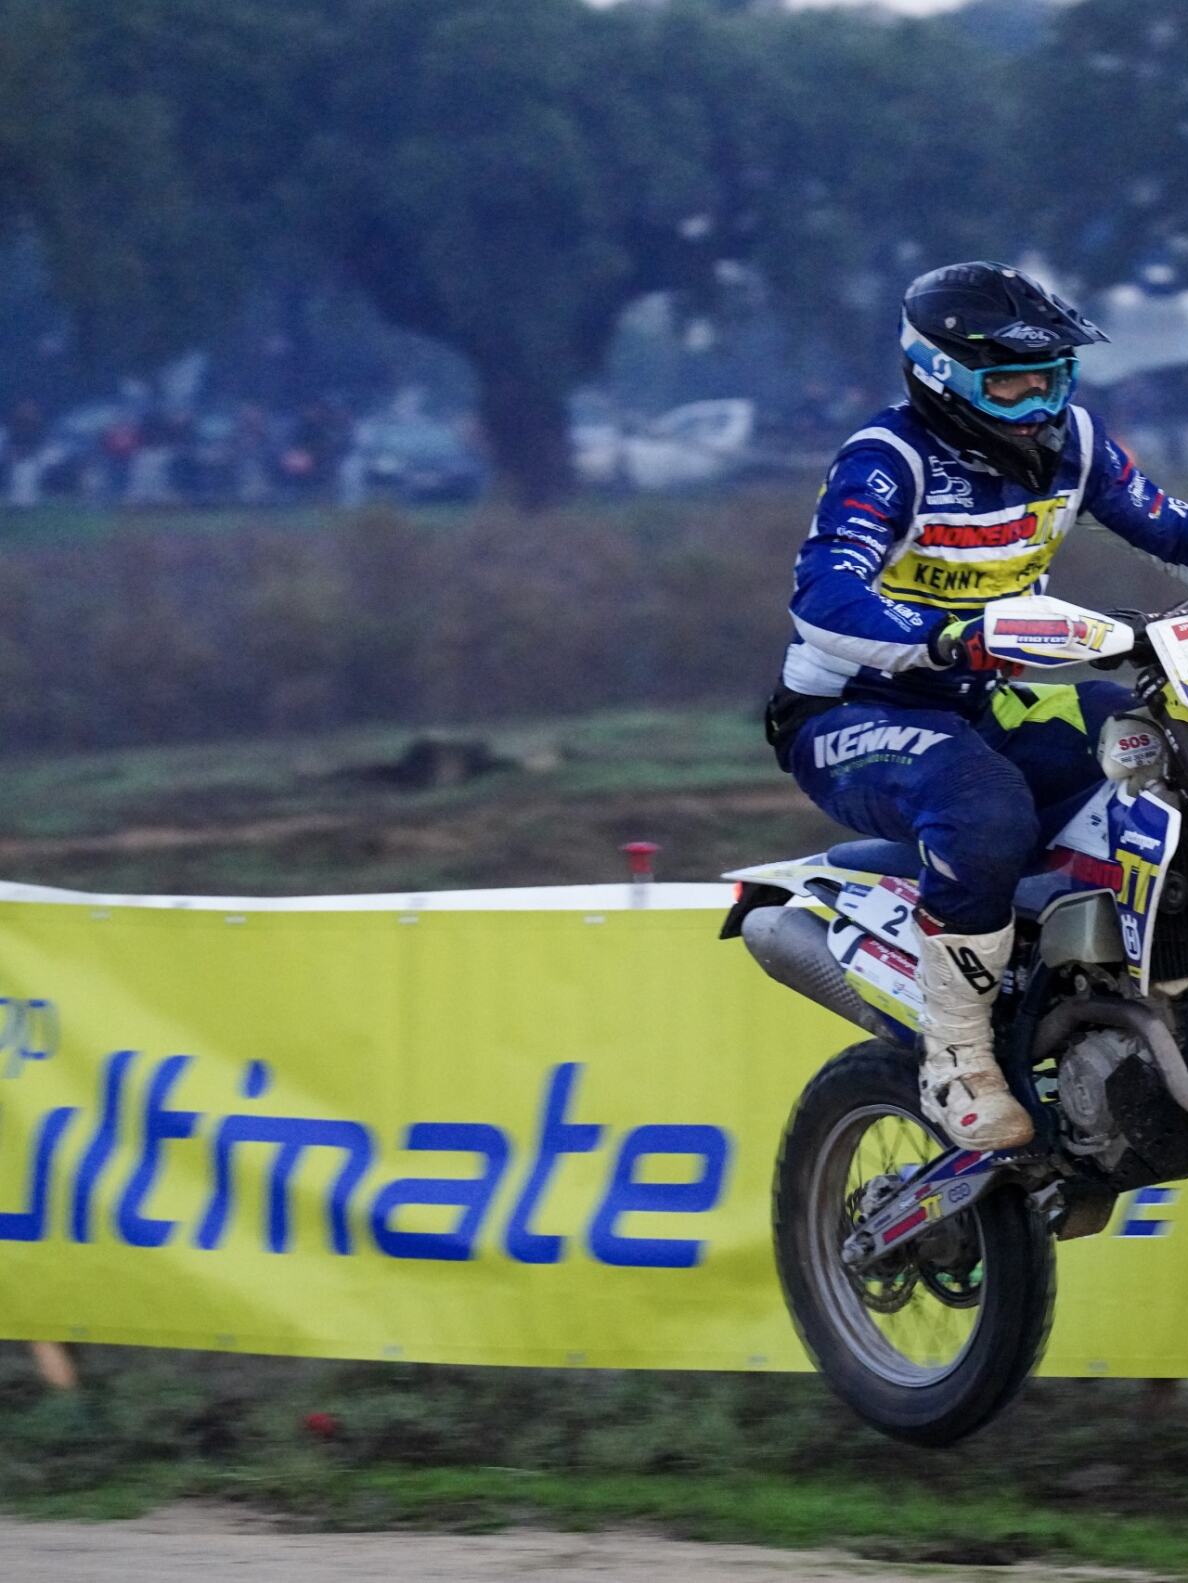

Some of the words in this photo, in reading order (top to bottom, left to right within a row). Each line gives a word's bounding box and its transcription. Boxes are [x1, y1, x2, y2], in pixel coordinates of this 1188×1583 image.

[914, 562, 986, 590] KENNY
[814, 719, 954, 768] KENNY
[1119, 734, 1150, 751] SOS
[881, 904, 908, 937] 2
